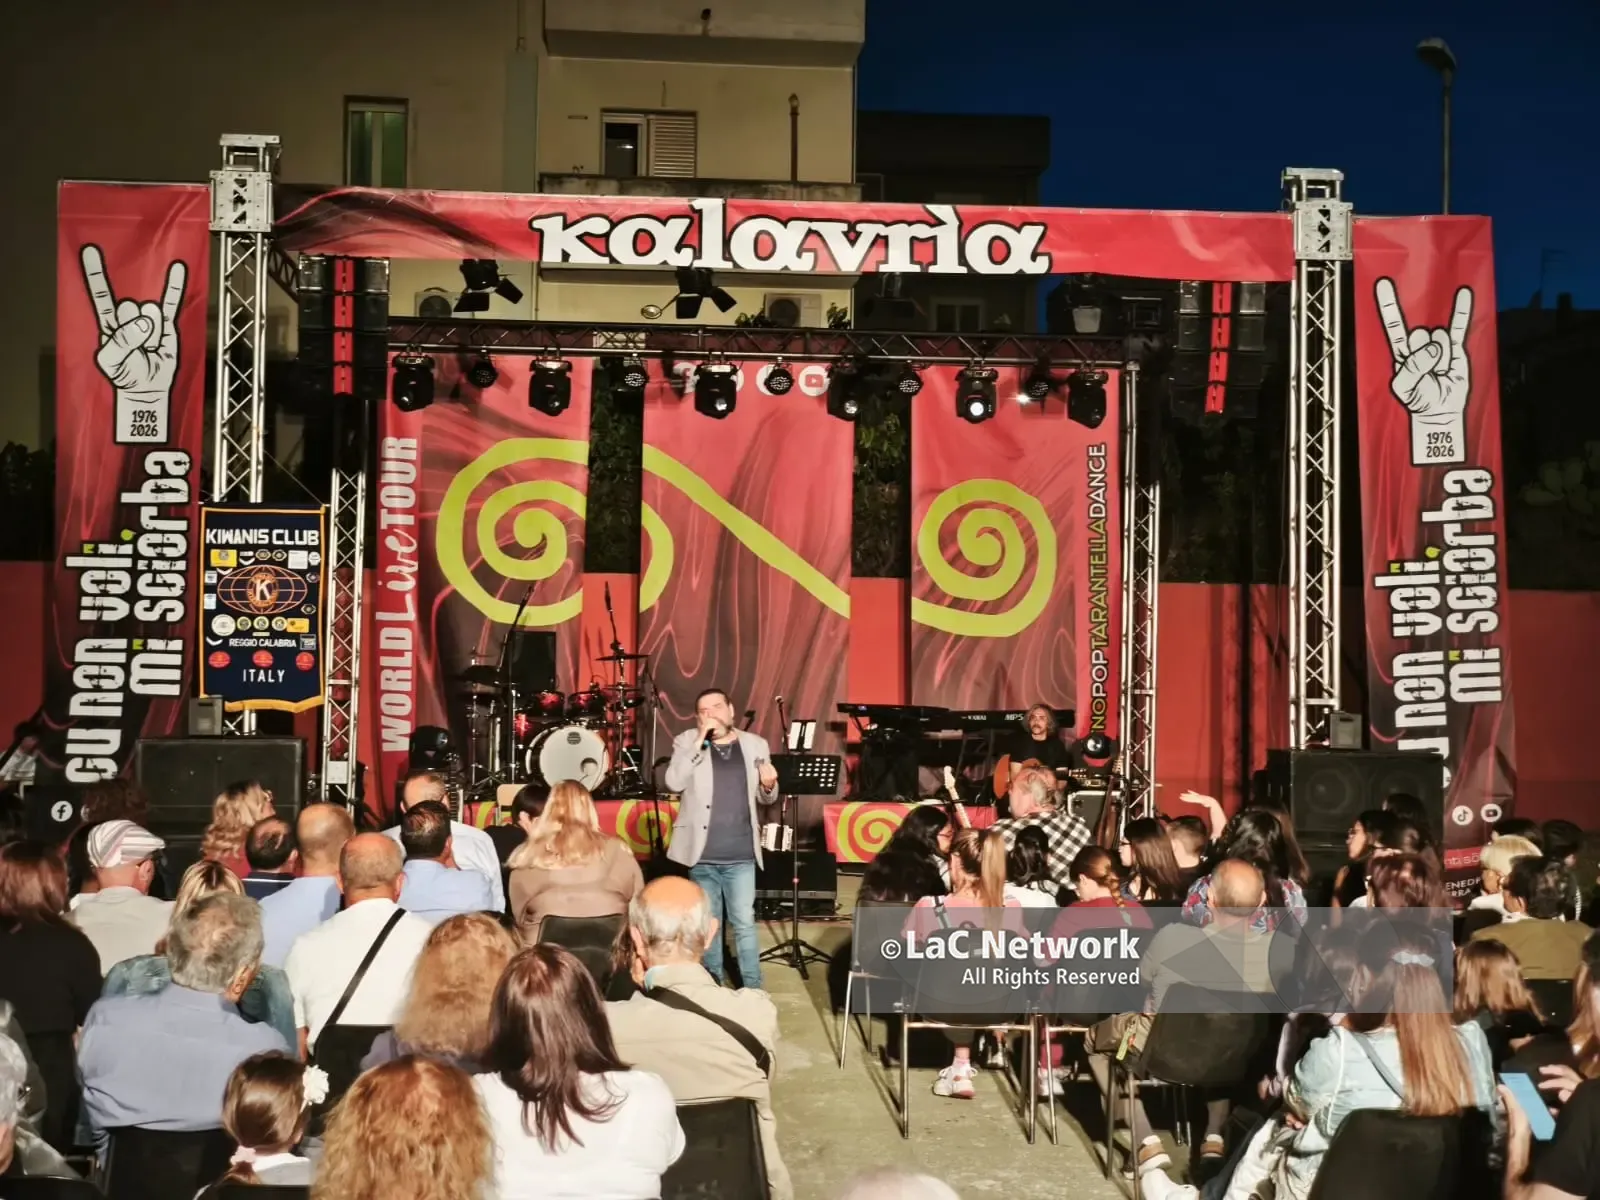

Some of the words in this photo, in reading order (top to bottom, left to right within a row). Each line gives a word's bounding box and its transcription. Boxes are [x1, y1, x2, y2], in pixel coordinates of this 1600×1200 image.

[132, 410, 157, 423] 1976
[130, 424, 158, 437] 2026
[1426, 432, 1453, 444] 1976
[1426, 445, 1455, 458] 2026
[380, 436, 417, 530] TOUR
[120, 450, 190, 622] sciorba
[206, 528, 269, 545] KIWANIS
[272, 529, 320, 545] CLUB
[1421, 469, 1499, 634] sciorba
[229, 638, 257, 647] REGGIO
[258, 639, 296, 648] CALABRIA
[69, 638, 128, 718] non
[242, 669, 285, 683] ITALY
[379, 627, 414, 752] WORLD
[1391, 651, 1447, 728] non
